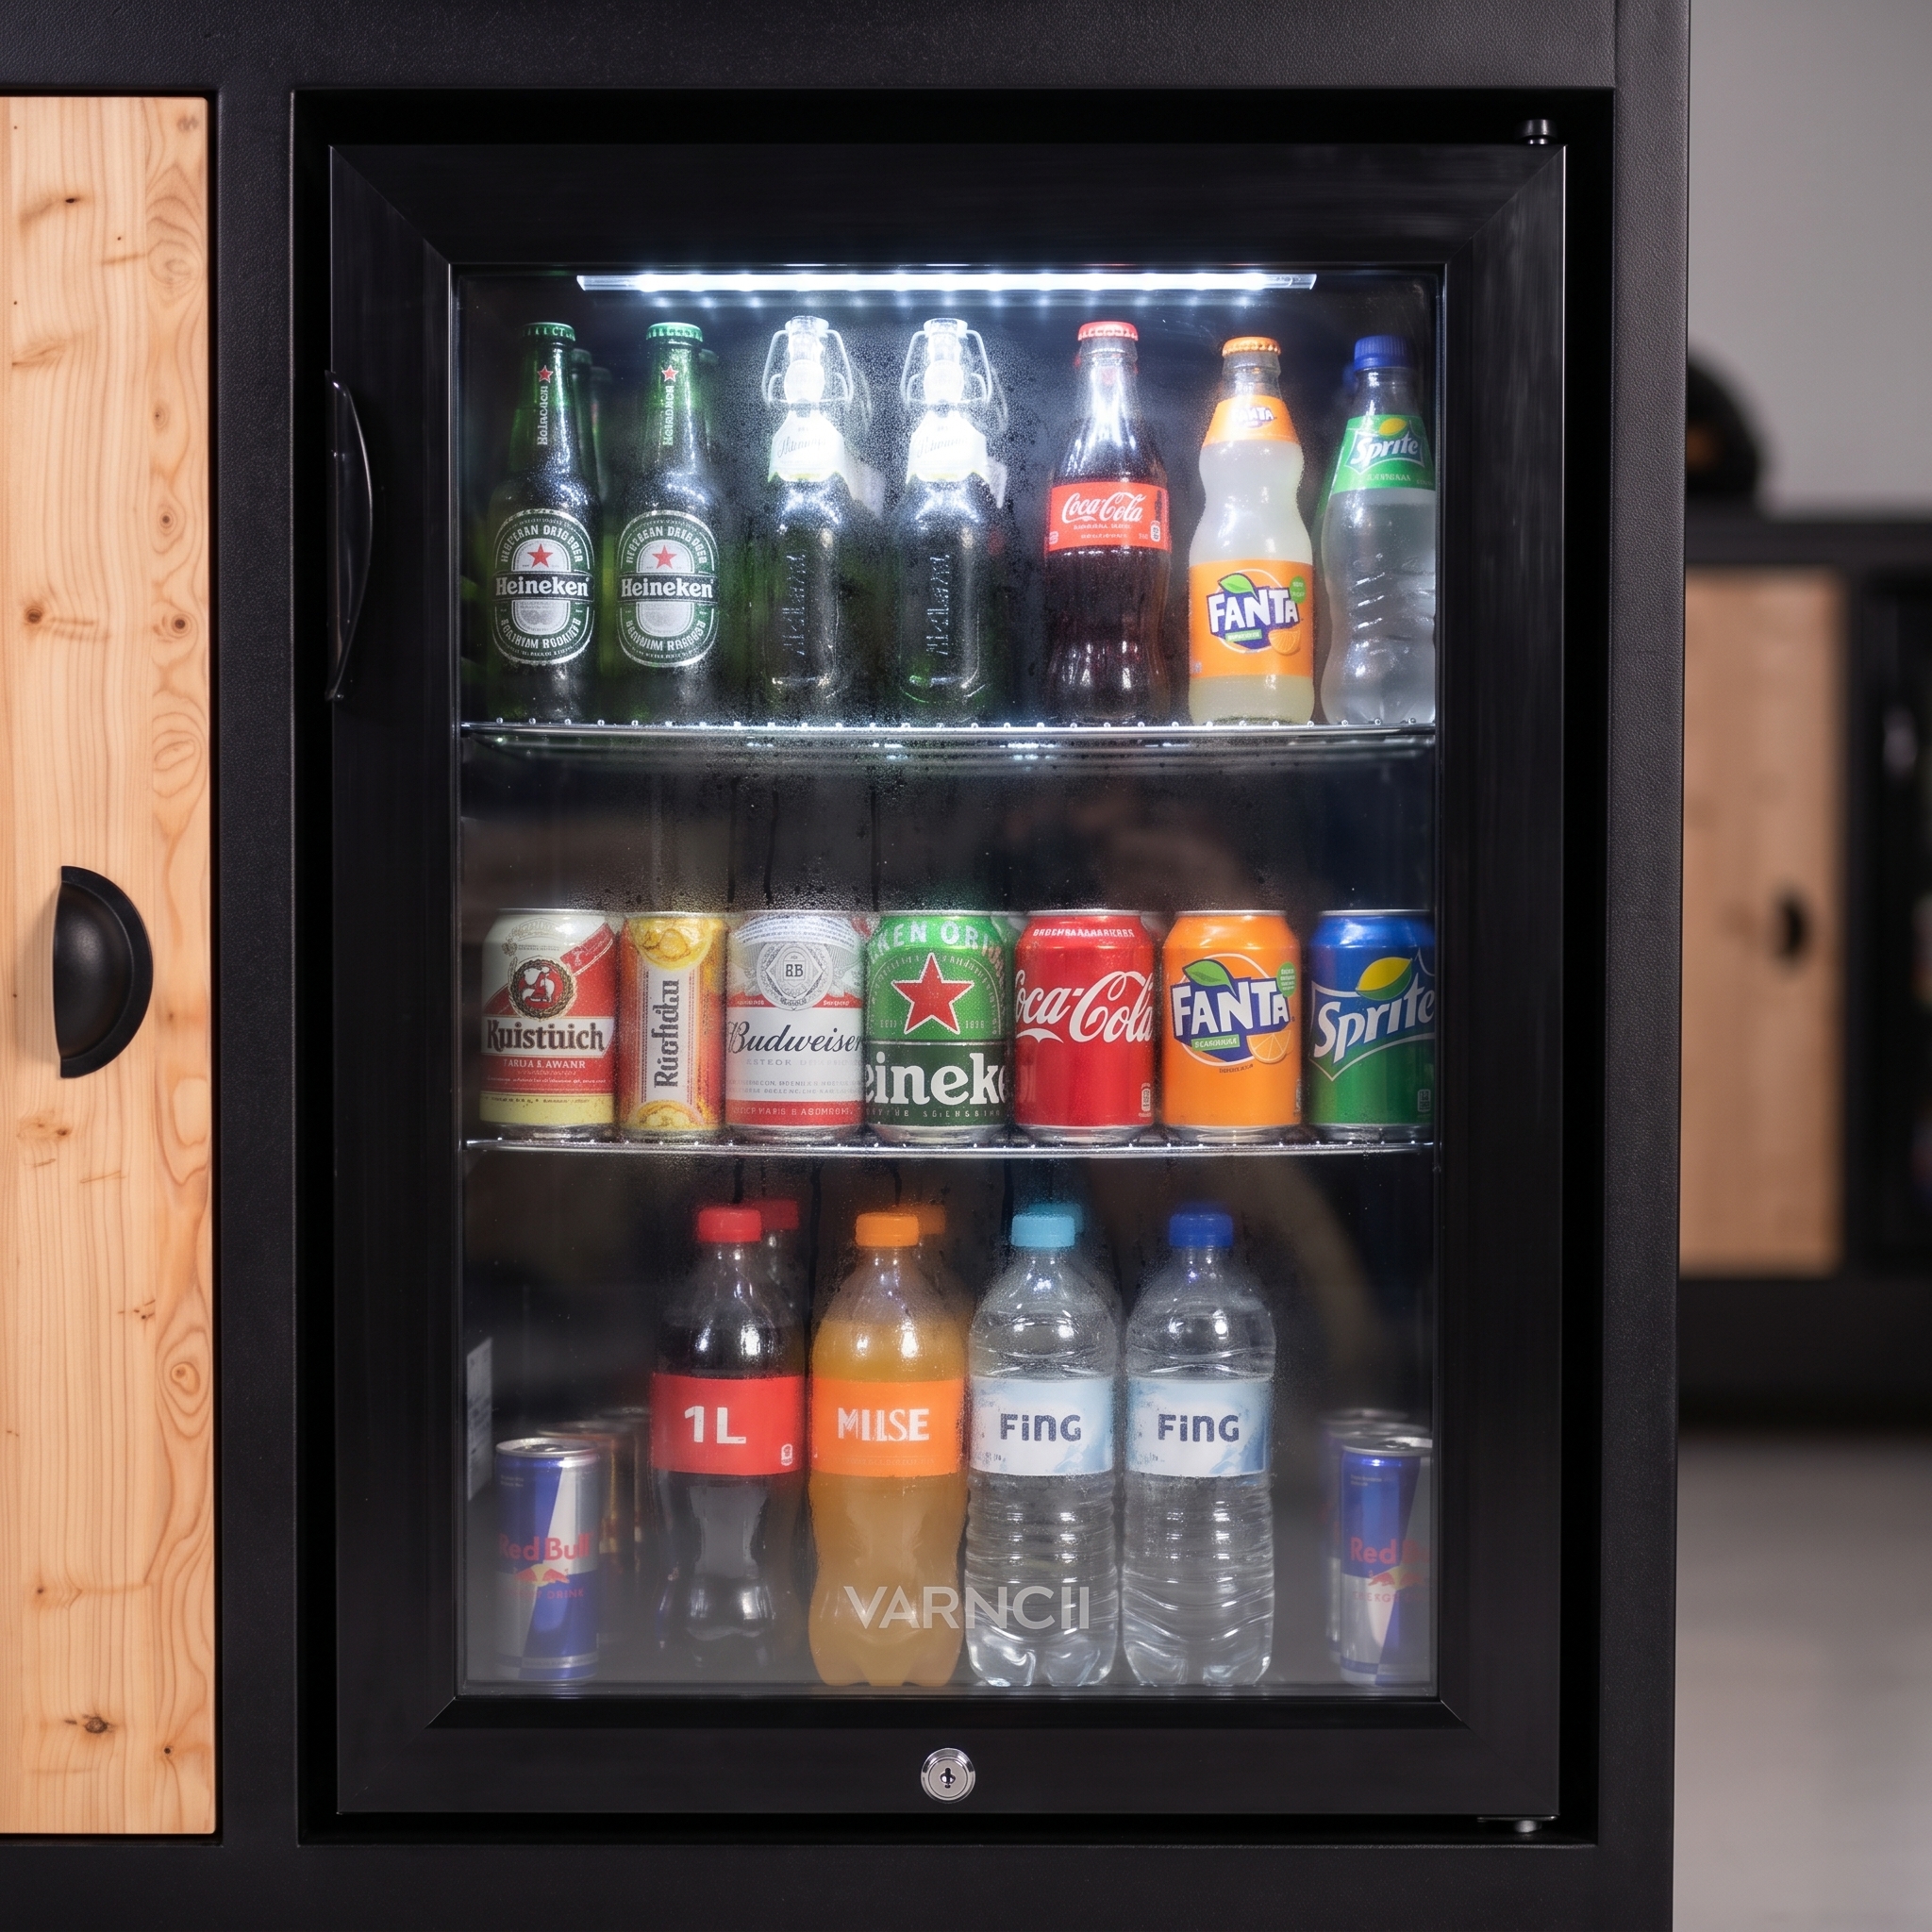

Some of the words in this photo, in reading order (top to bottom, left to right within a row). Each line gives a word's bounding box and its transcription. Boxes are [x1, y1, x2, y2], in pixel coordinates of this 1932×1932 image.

[1350, 431, 1419, 469] Sprite
[495, 576, 589, 597] Heineken
[621, 578, 713, 598] Heineken
[1208, 589, 1299, 633] FANTA
[1015, 969, 1154, 1044] oca-Cola
[1172, 981, 1290, 1037] FANTA
[1313, 973, 1435, 1064] Sprite
[865, 1051, 1006, 1106] inek
[544, 1533, 591, 1561] Bull
[1350, 1537, 1397, 1565] Red
